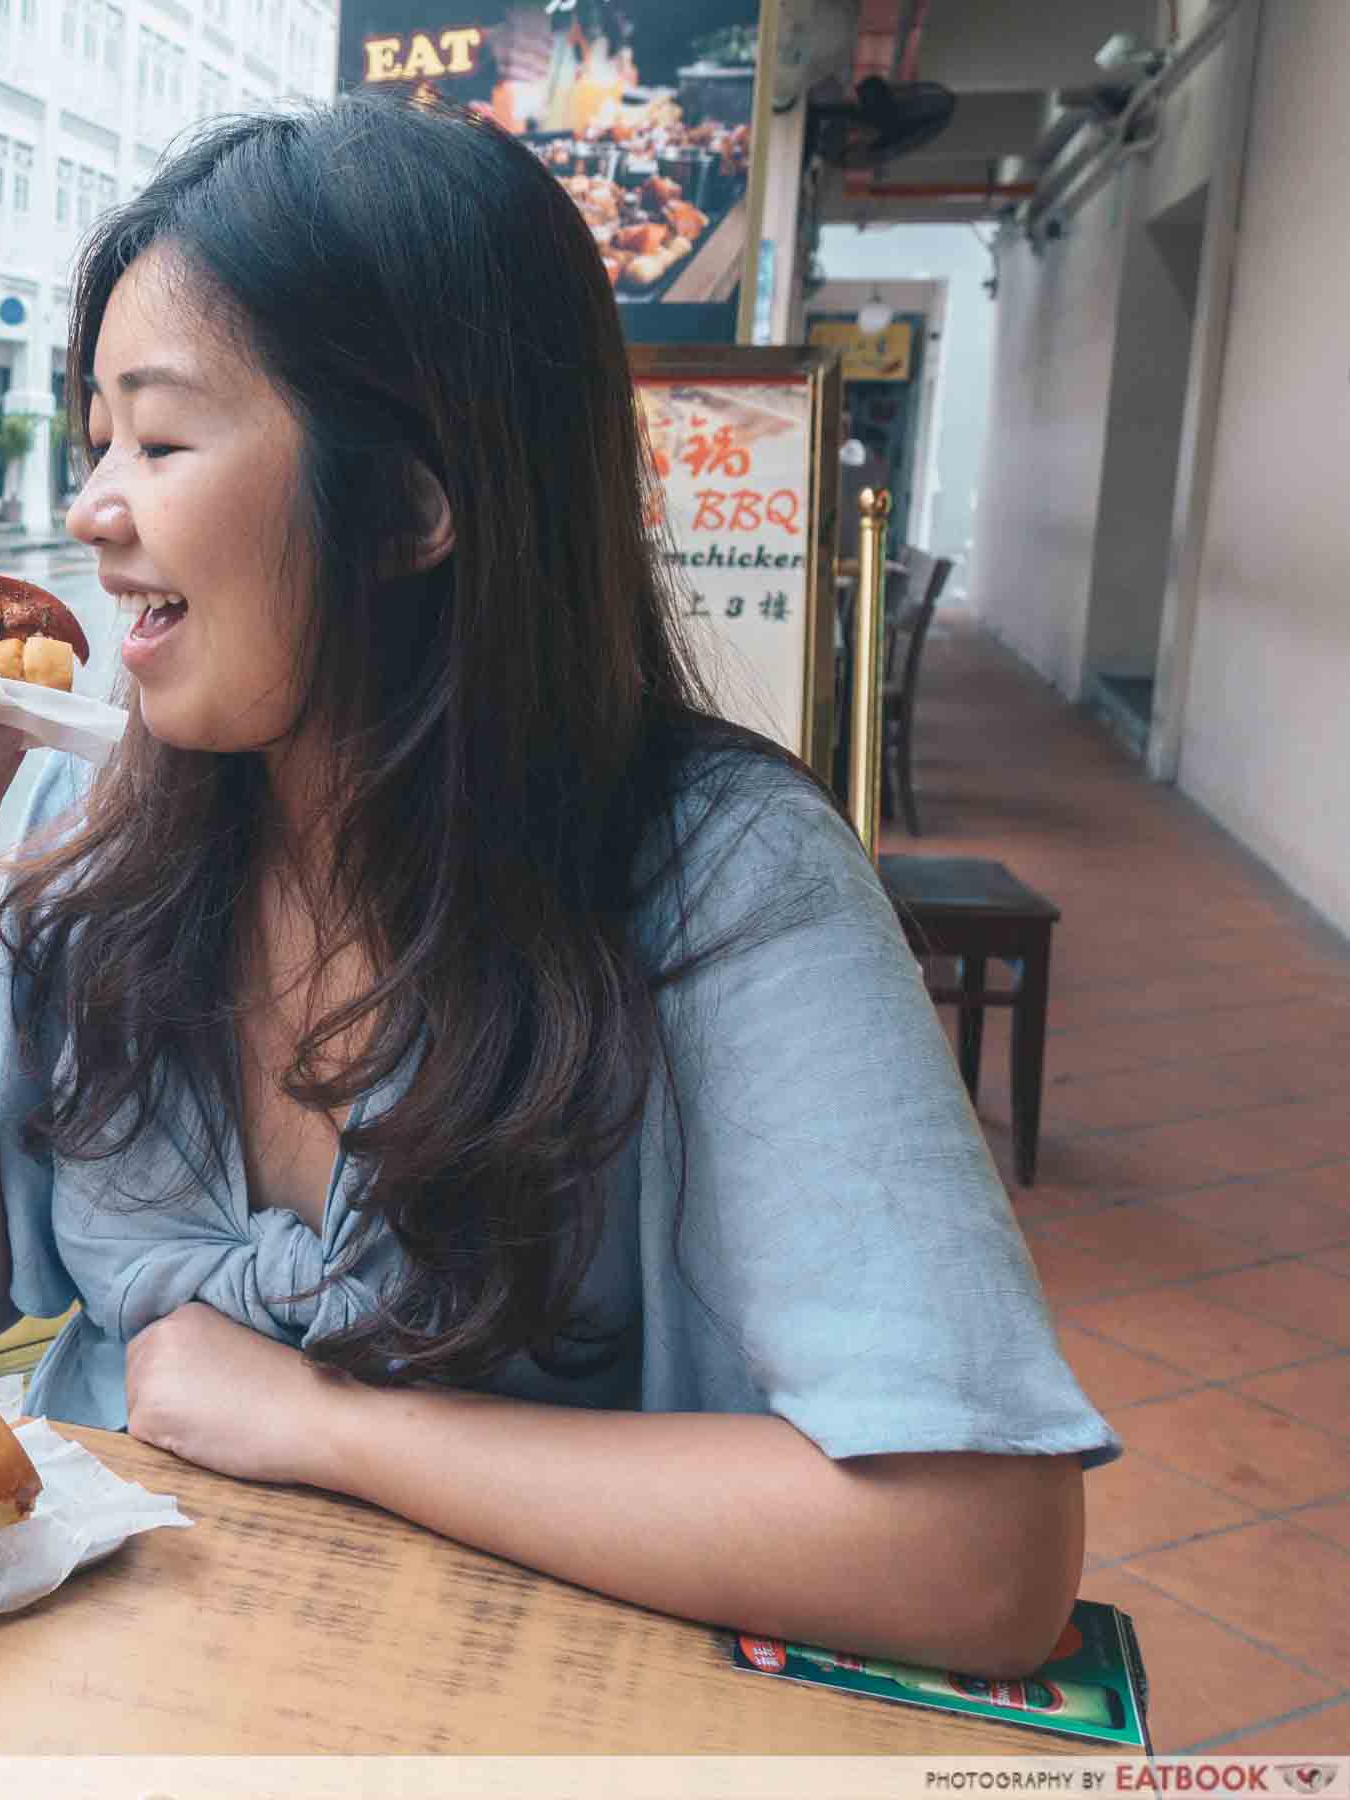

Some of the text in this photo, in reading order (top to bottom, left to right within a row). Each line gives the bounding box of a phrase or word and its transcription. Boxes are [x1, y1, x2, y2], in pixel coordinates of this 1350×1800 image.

[364, 28, 482, 82] EAT
[692, 488, 802, 536] BBQ
[663, 543, 804, 569] mchicke
